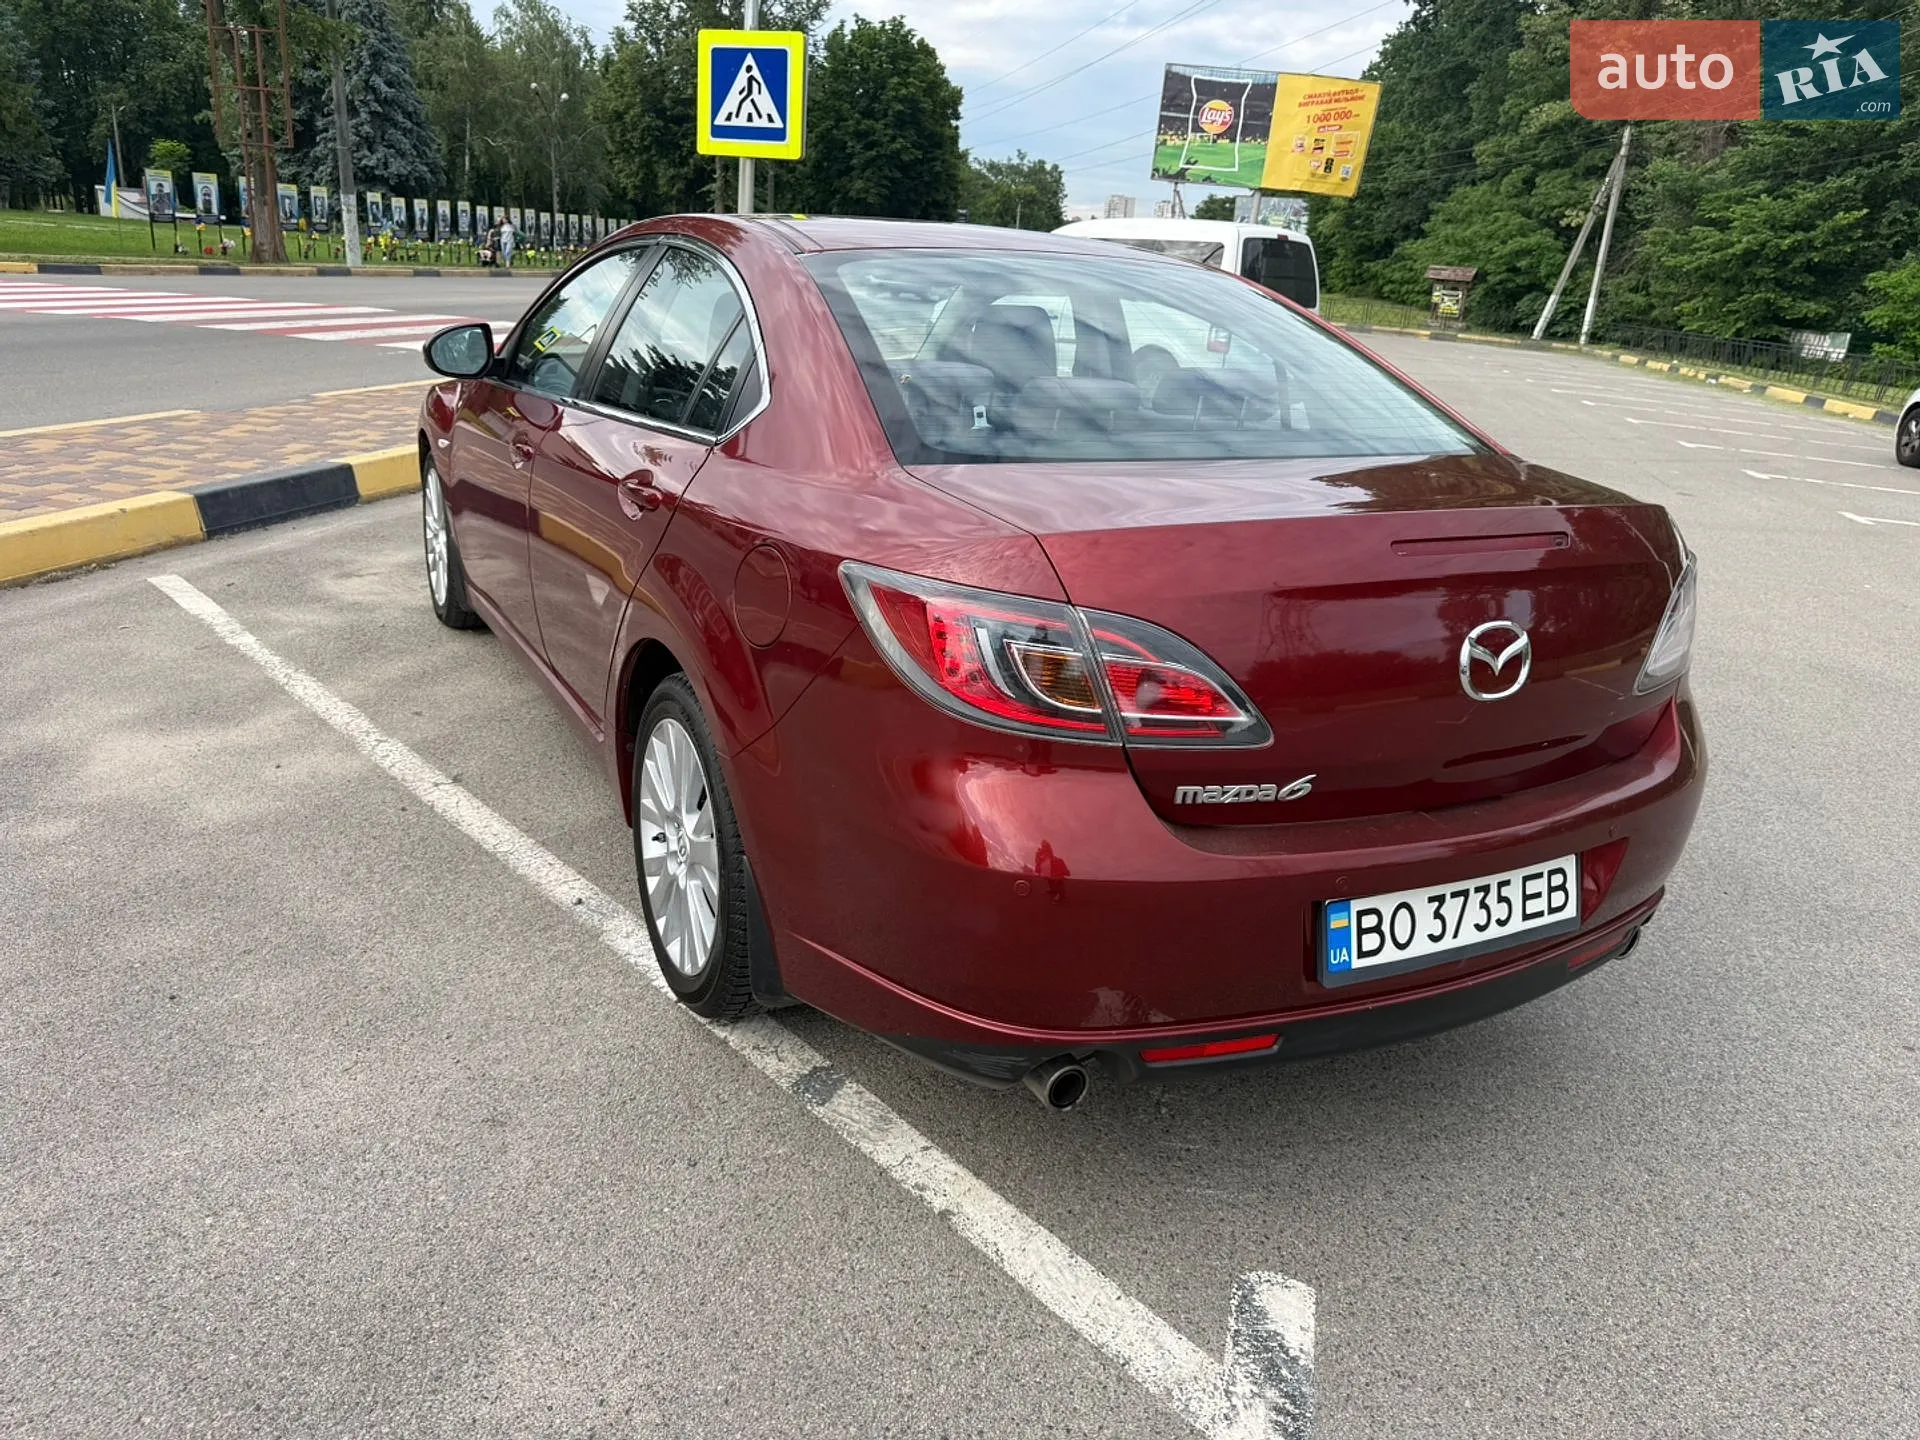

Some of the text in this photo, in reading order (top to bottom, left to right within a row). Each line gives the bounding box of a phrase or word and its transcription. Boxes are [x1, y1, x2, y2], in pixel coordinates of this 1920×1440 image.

[1355, 866, 1570, 960] BO 3735 EB
[1330, 947, 1350, 965] UA
